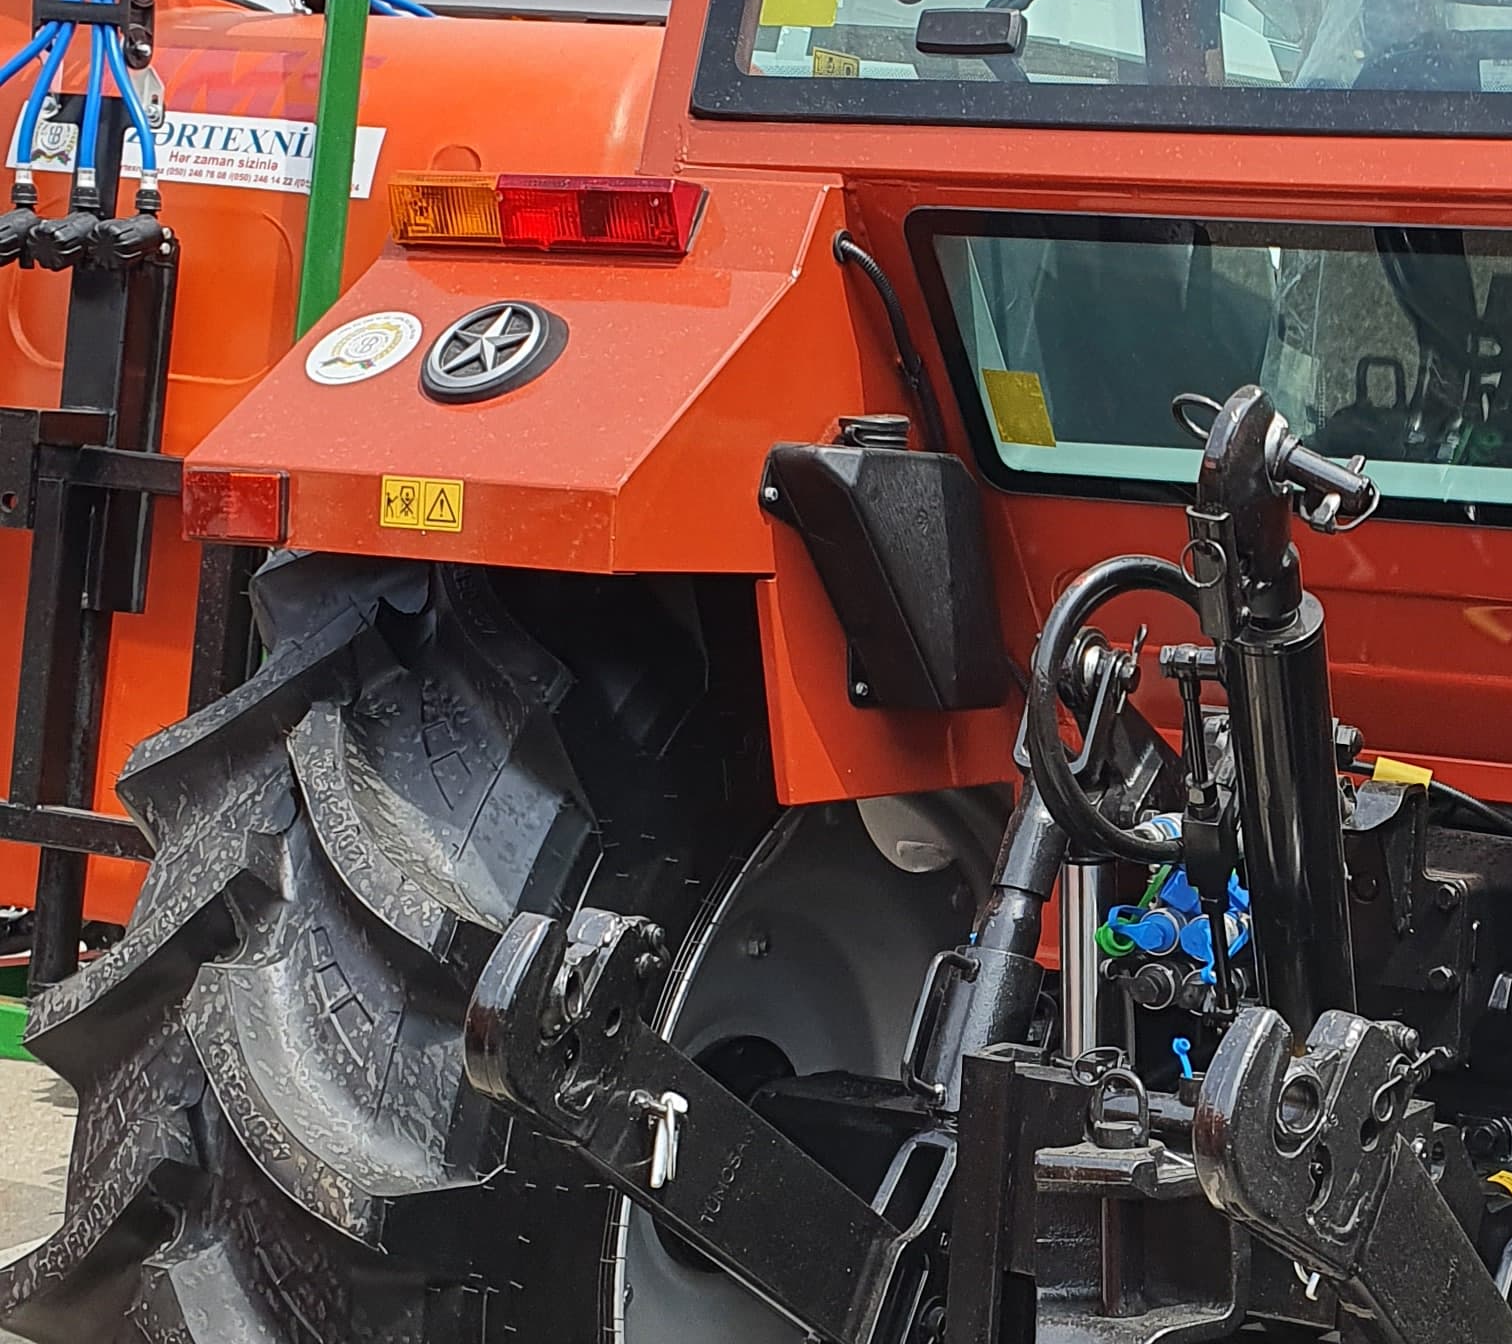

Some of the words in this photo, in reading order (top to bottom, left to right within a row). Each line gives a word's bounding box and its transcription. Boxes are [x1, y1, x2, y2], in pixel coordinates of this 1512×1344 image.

[168, 150, 191, 165] Hər
[193, 154, 236, 169] zaman
[237, 155, 279, 172] sizinlə
